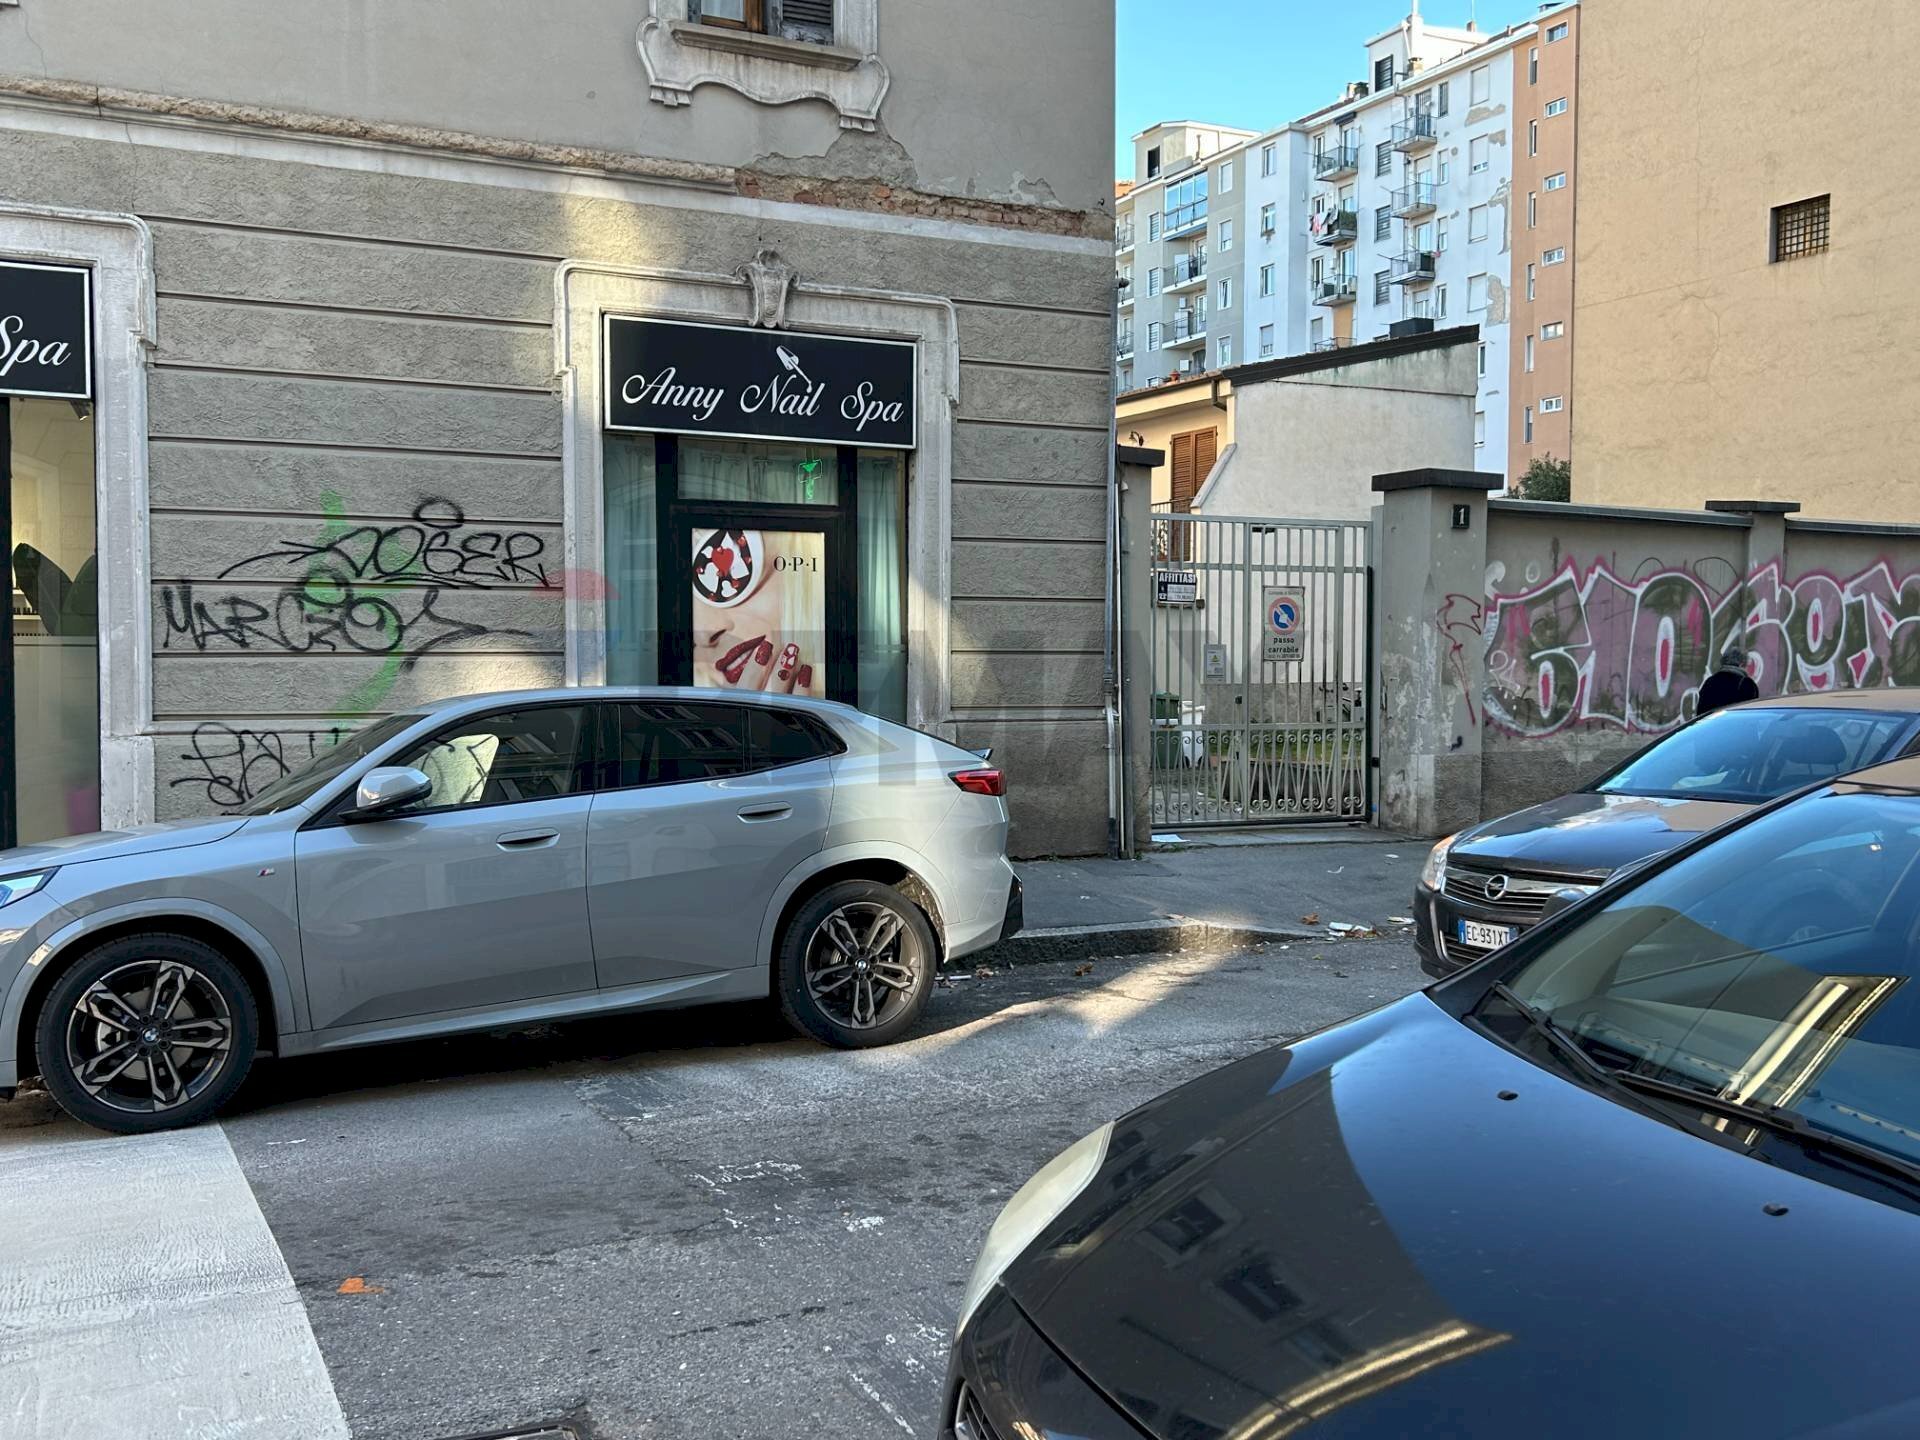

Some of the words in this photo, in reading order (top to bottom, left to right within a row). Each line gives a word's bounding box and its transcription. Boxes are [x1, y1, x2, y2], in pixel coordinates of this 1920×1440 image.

[621, 366, 725, 421] Anny
[740, 374, 826, 417] Nail
[840, 381, 905, 432] Spa
[1459, 507, 1465, 525] 1
[1159, 572, 1196, 583] AFFITTASI
